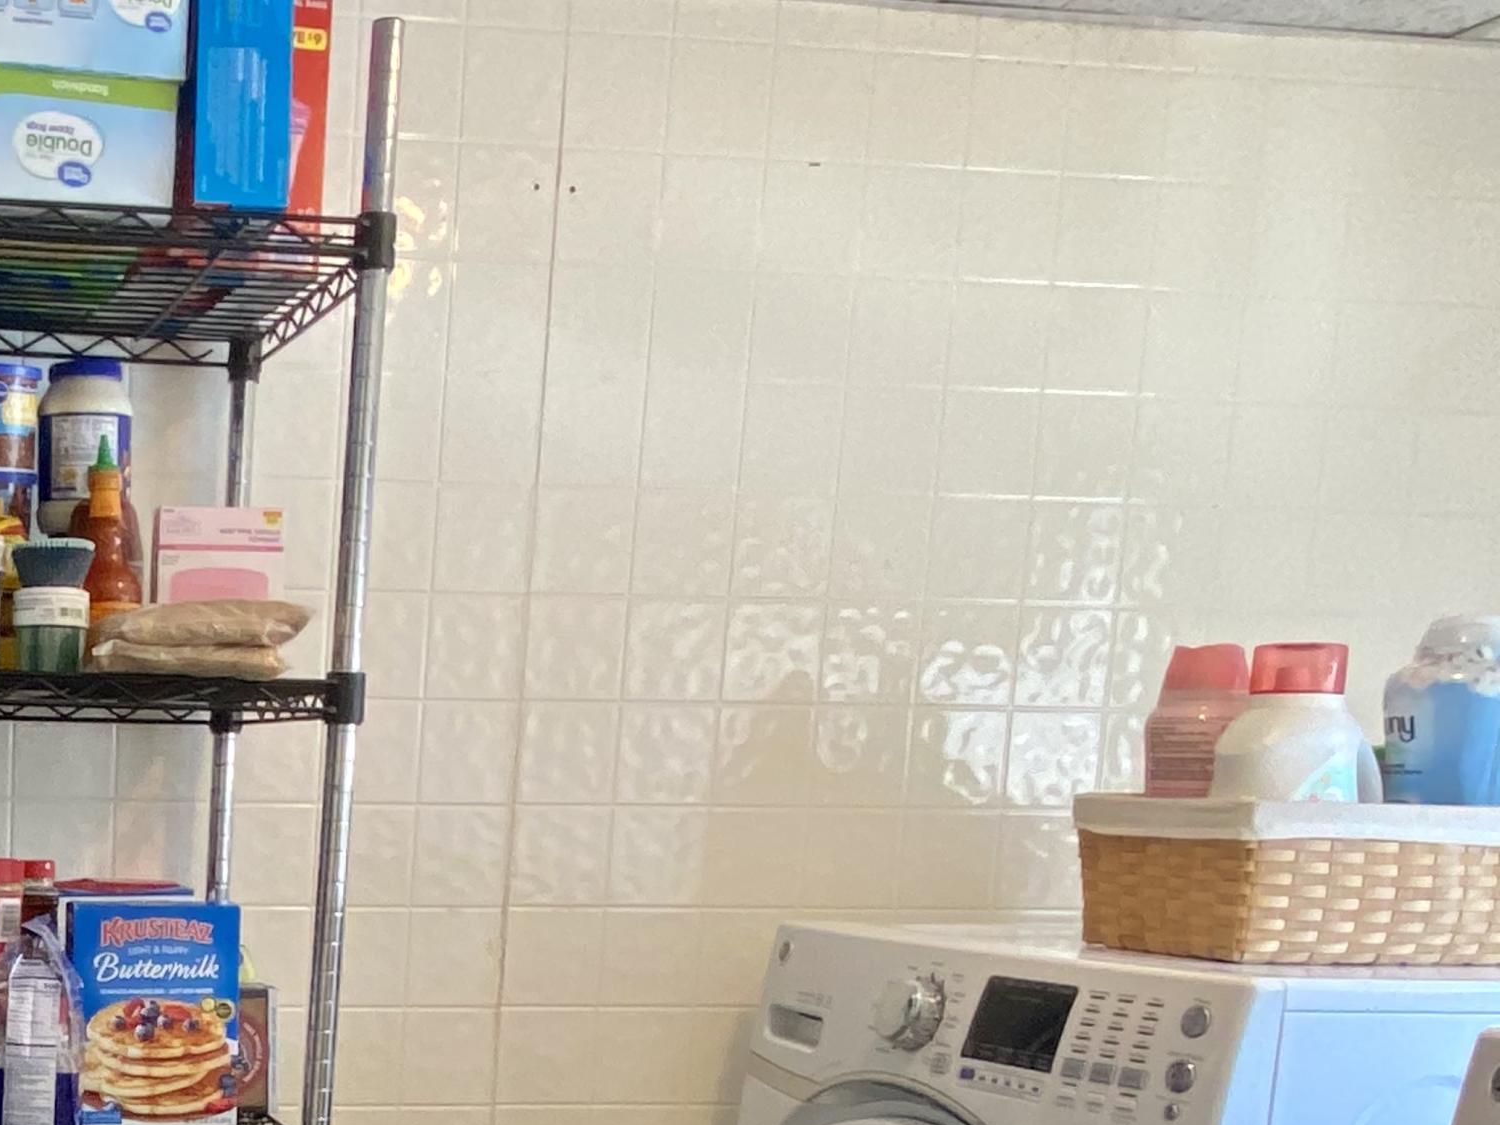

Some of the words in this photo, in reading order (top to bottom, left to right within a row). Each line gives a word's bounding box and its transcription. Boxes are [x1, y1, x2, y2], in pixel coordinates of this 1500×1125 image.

[25, 133, 93, 158] Double
[100, 916, 214, 948] KRUSTEAZ
[93, 951, 220, 982] Buttermilk
